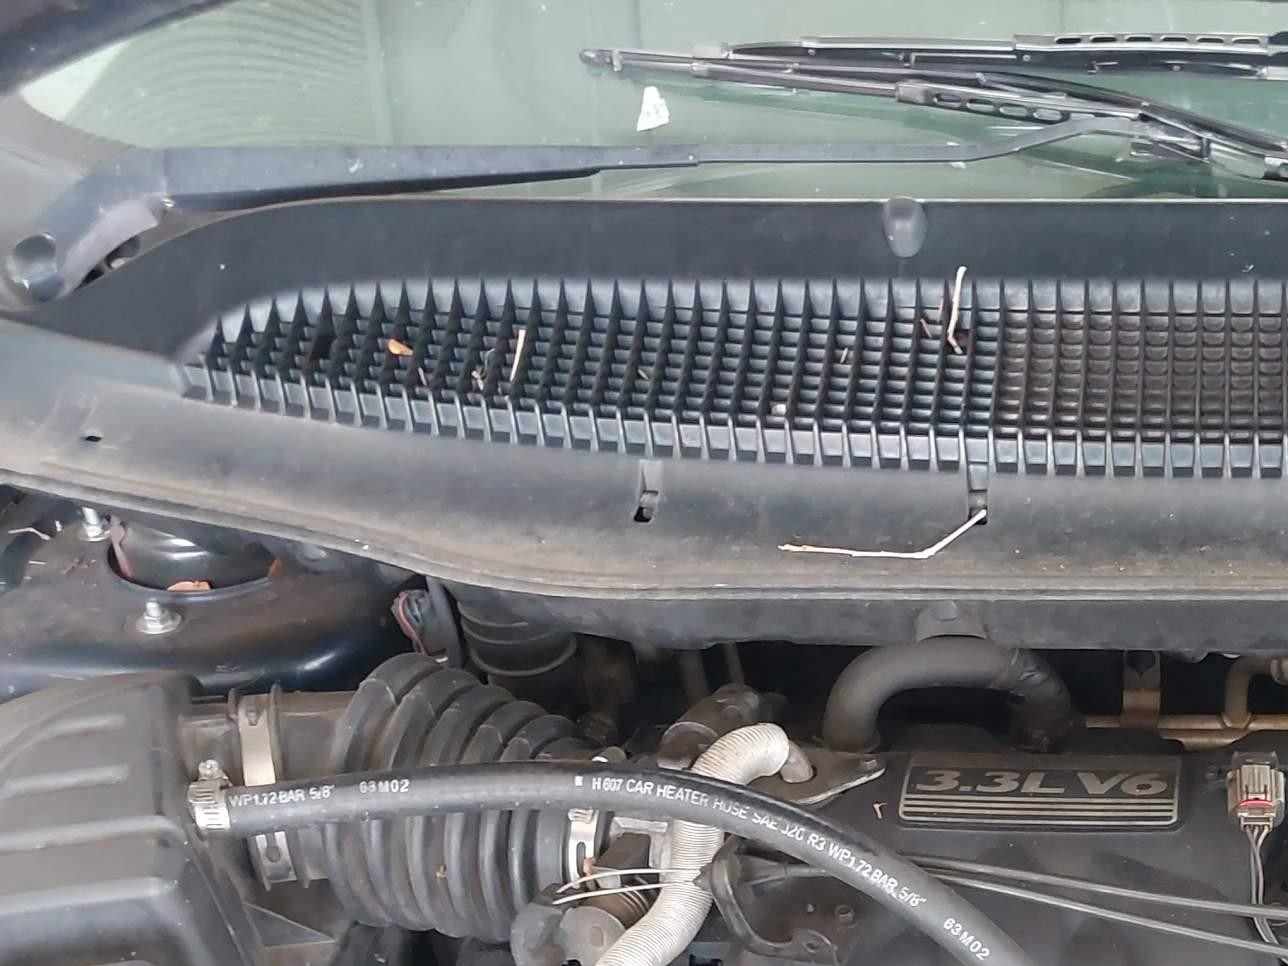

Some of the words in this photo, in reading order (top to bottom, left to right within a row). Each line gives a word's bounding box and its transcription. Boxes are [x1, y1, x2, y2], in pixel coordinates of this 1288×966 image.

[915, 769, 1066, 794] 3.3L
[1077, 771, 1168, 795] V6
[626, 778, 655, 796] CAR
[656, 785, 710, 807] HEATER
[713, 798, 750, 819] HOSE
[807, 832, 827, 852] R3
